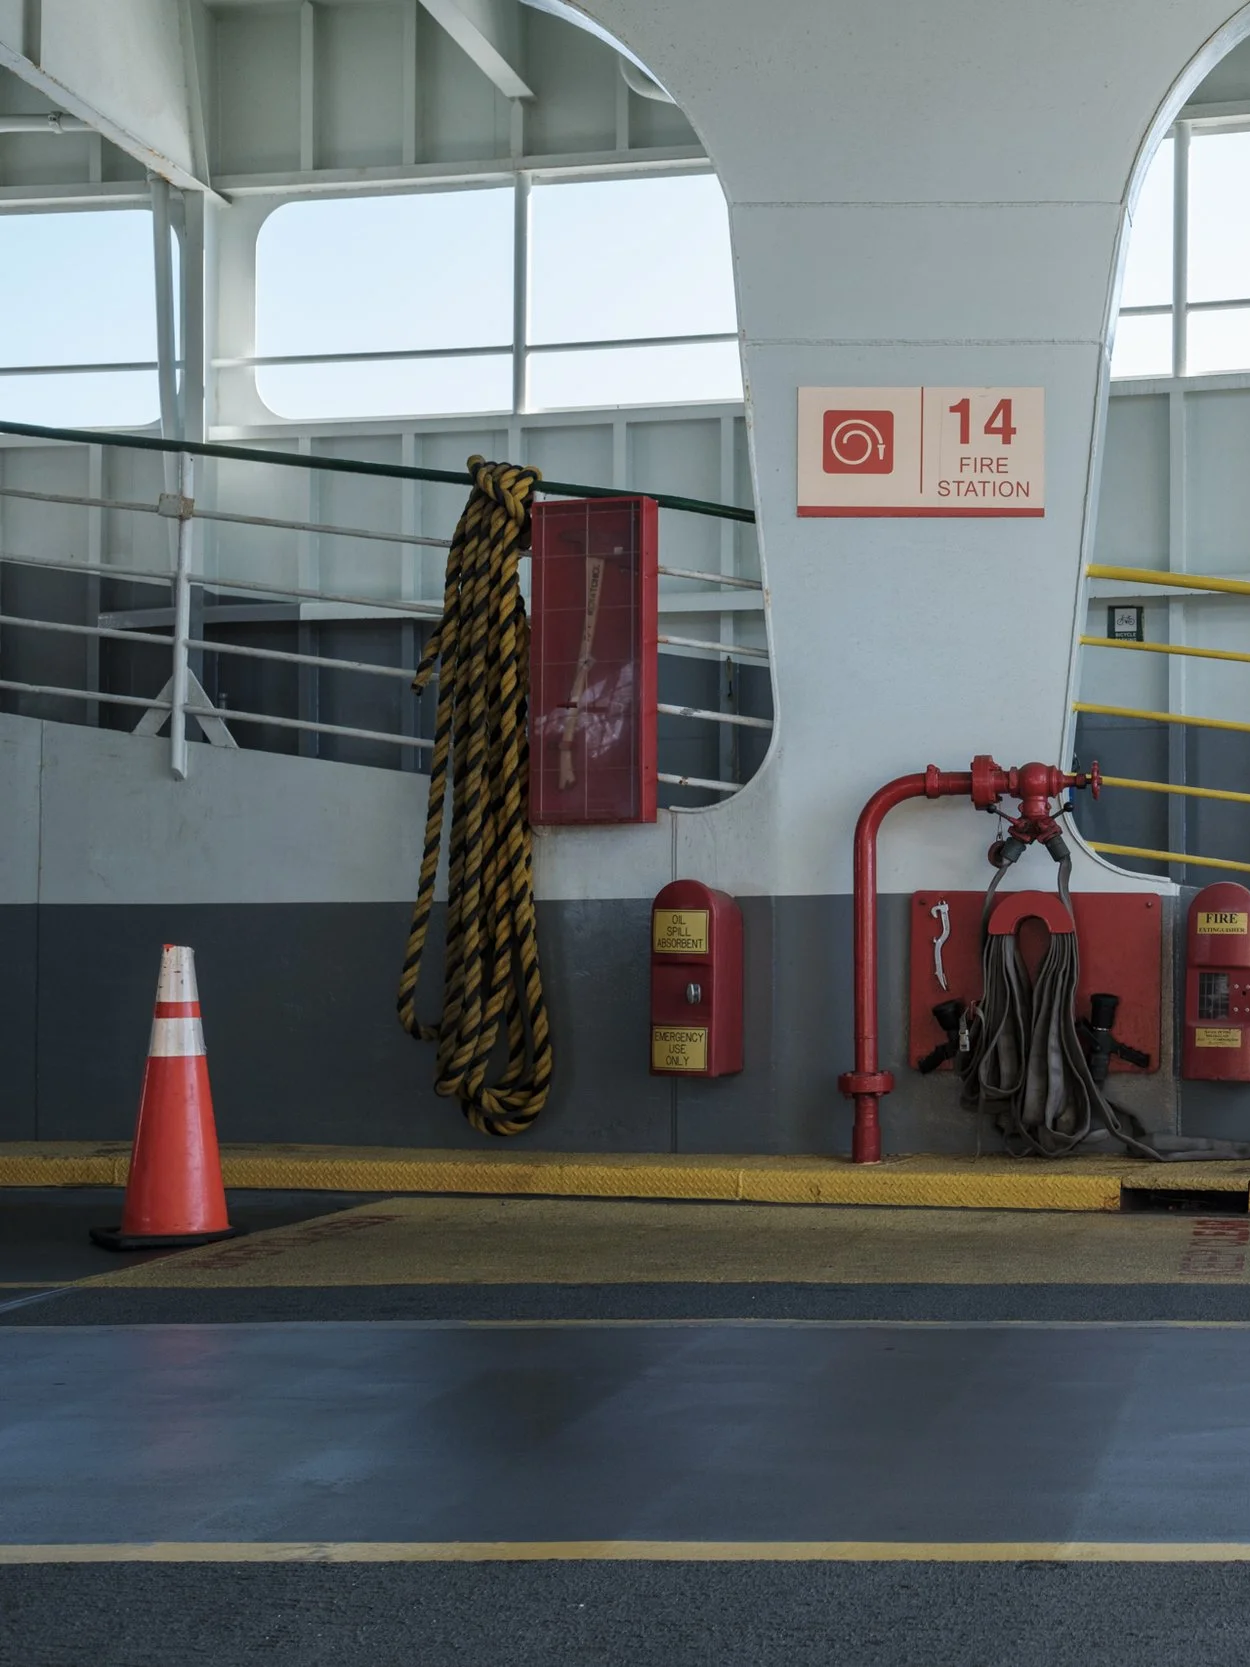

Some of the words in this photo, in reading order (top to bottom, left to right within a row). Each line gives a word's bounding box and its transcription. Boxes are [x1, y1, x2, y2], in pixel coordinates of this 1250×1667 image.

[949, 398, 1017, 445] 14
[959, 457, 1009, 474] FIRE
[937, 480, 1031, 498] STATION
[671, 914, 687, 926] OIL
[1205, 912, 1239, 924] FIRE
[666, 926, 692, 937] SPILL
[656, 938, 704, 949] ABSORBENT
[654, 1031, 705, 1043] EMERGENCY
[668, 1043, 687, 1054] USE
[665, 1055, 690, 1066] ONLY
